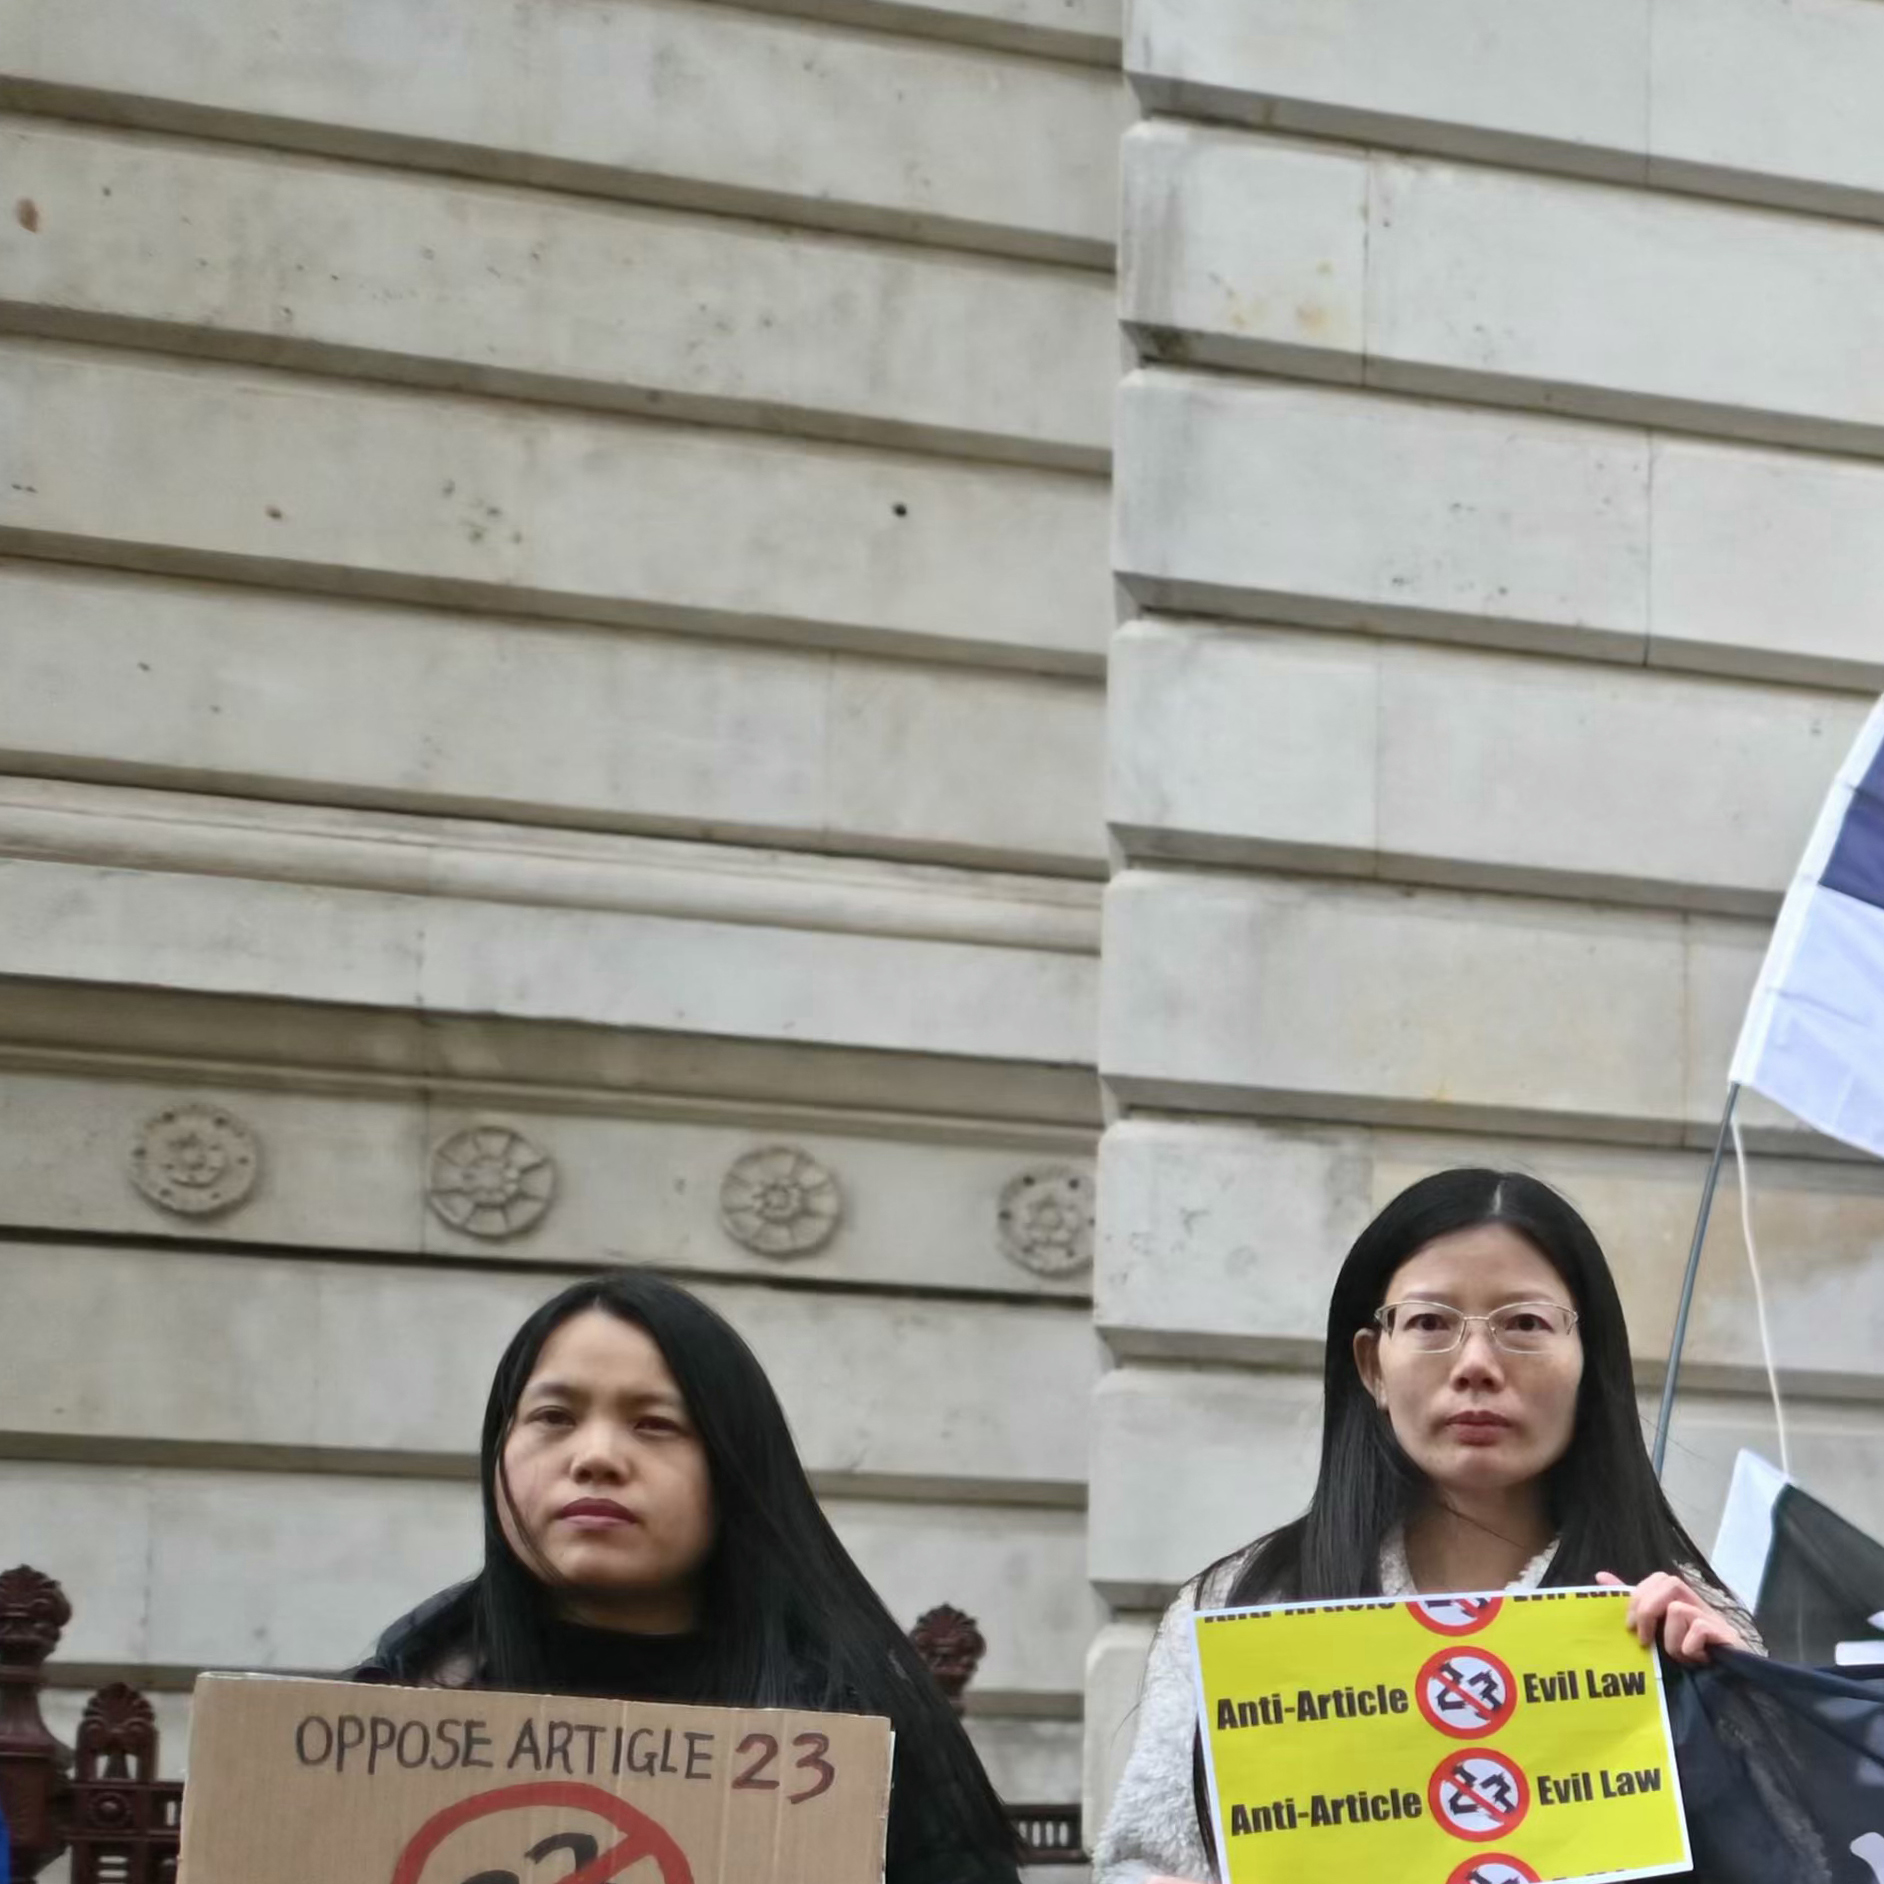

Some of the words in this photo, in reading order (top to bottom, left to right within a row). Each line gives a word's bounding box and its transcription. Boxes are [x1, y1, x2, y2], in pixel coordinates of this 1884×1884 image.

[1217, 1684, 1410, 1731] Anti-Article
[1524, 1671, 1580, 1704] Evil
[1587, 1669, 1646, 1698] Law
[294, 1716, 493, 1775] OPPOSE
[730, 1733, 835, 1803] 23
[1231, 1788, 1423, 1837] Anti-Article
[1538, 1774, 1593, 1806] Evil
[1601, 1767, 1662, 1797] Law
